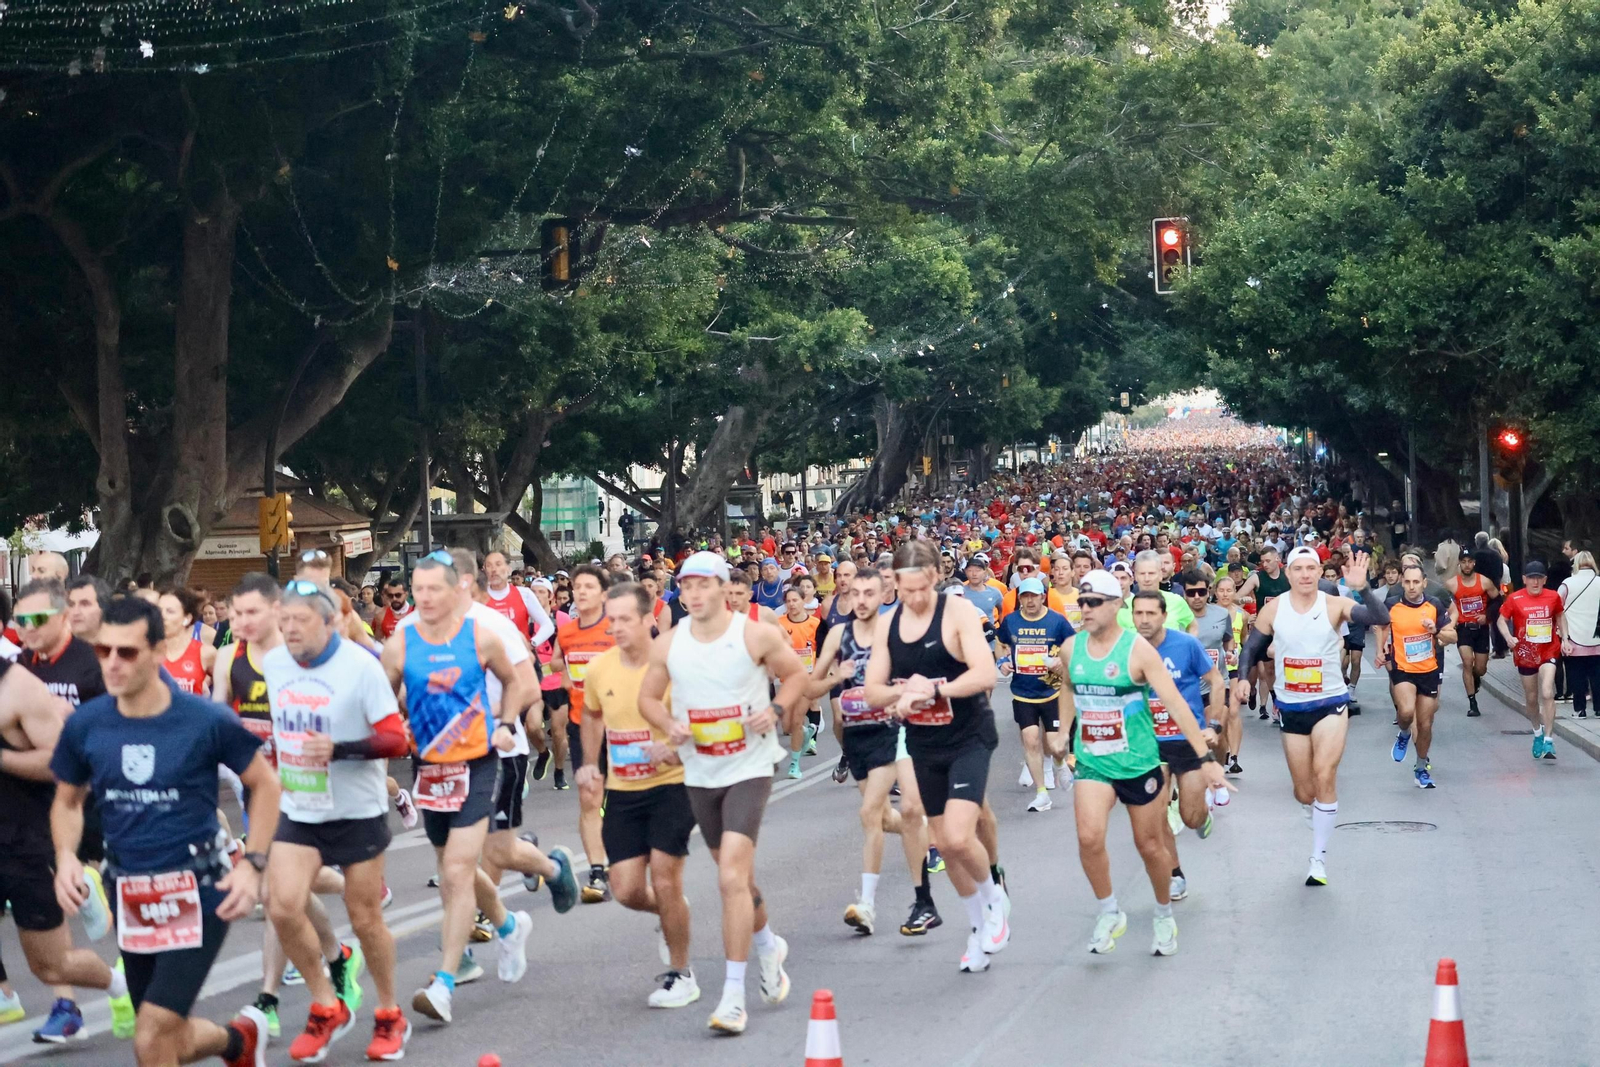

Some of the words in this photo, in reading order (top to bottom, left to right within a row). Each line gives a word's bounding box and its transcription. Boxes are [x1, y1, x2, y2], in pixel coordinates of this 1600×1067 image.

[1018, 628, 1046, 636] STEVE
[278, 689, 330, 712] Chicago
[1086, 726, 1115, 736] 10296
